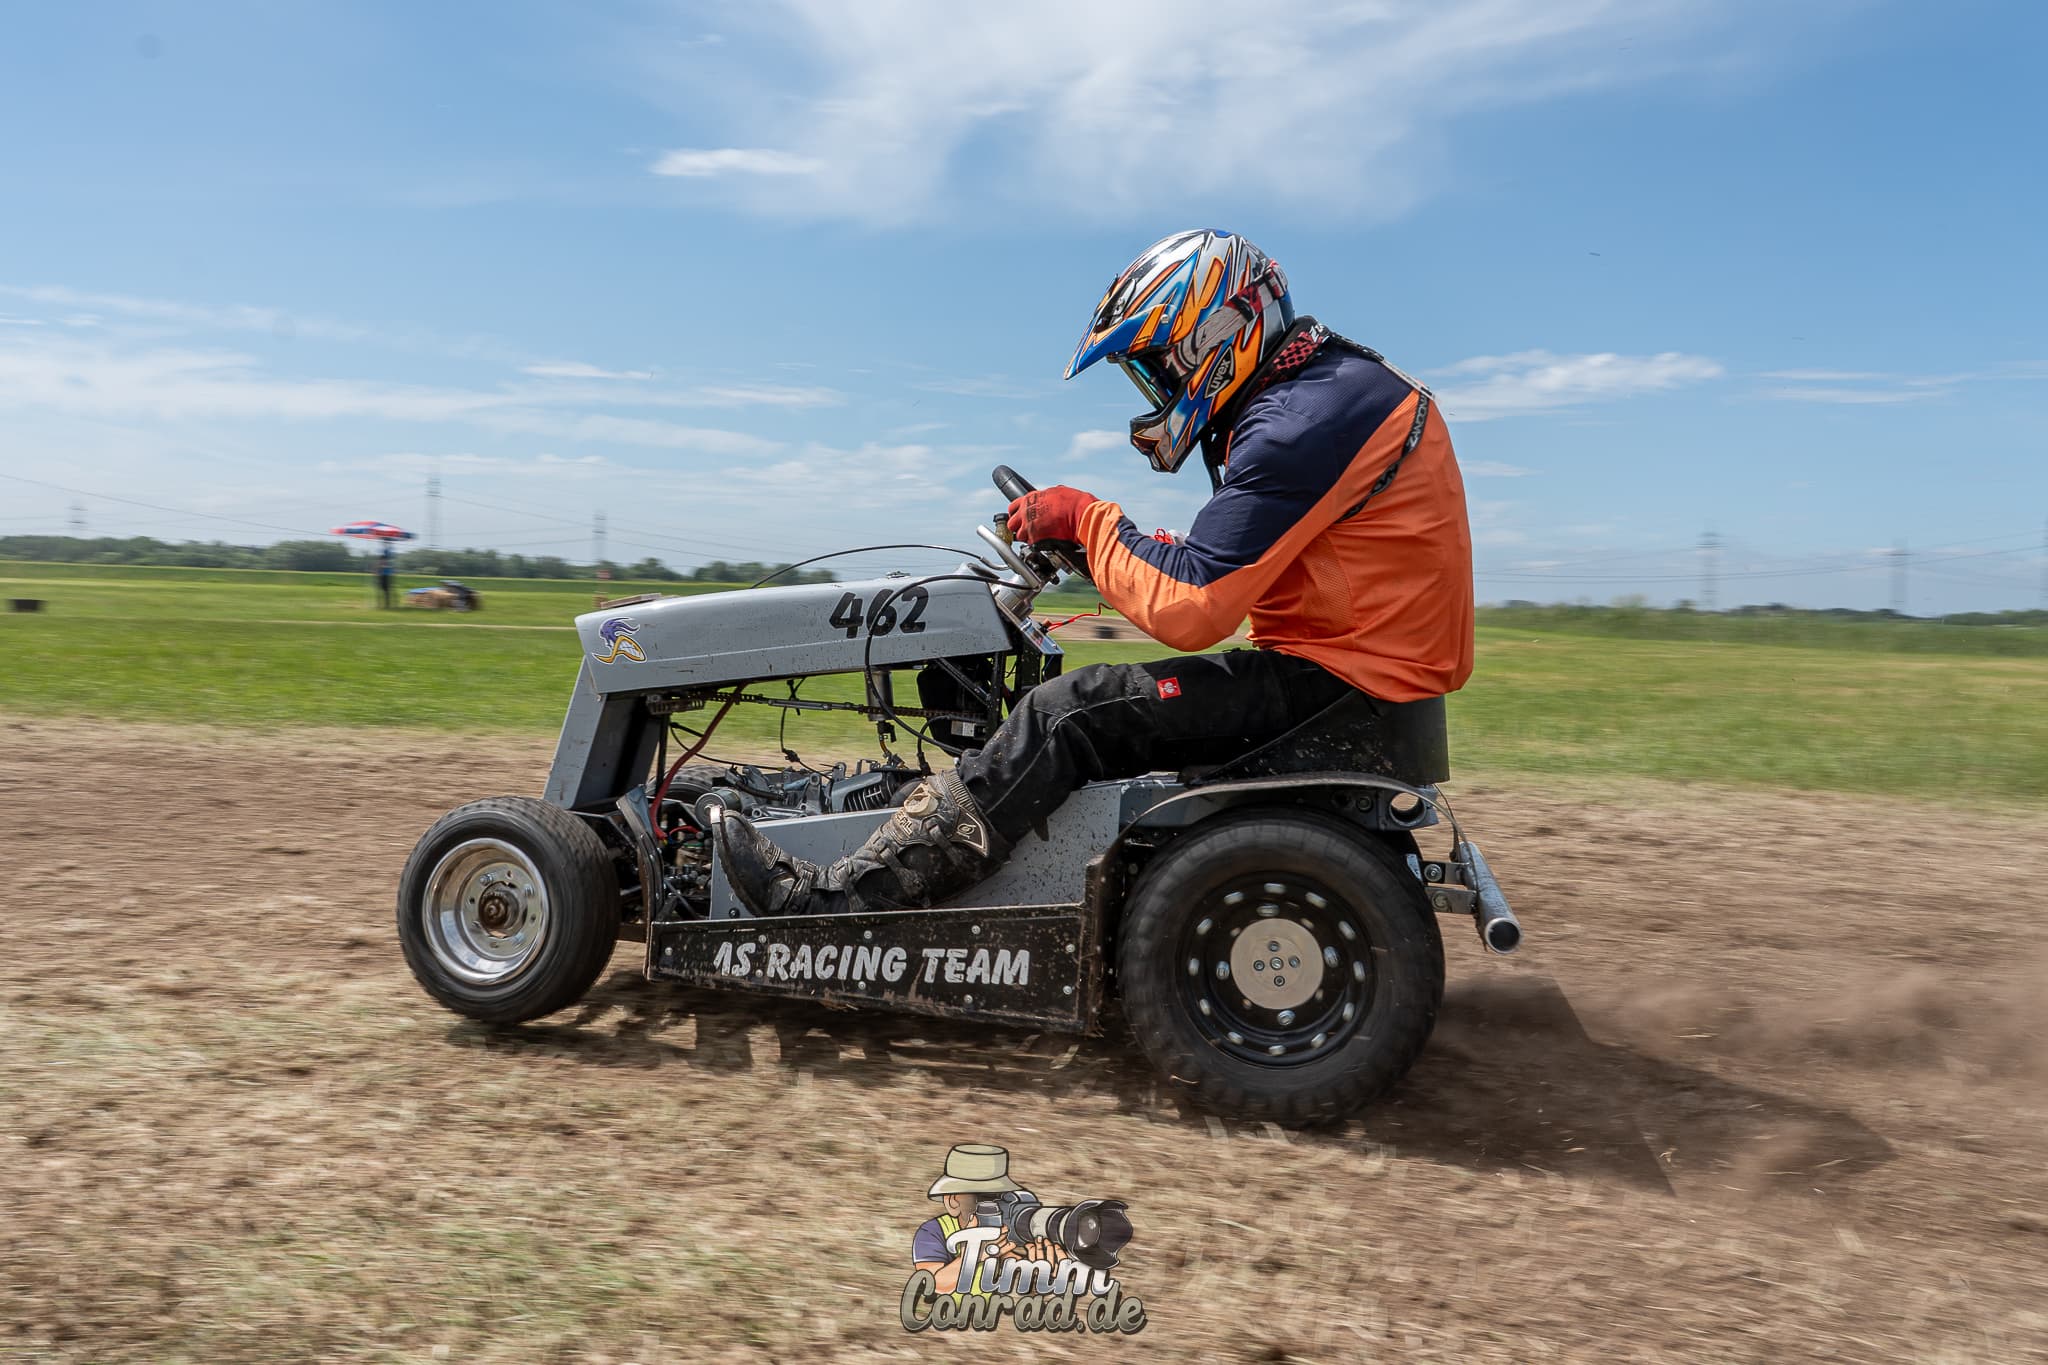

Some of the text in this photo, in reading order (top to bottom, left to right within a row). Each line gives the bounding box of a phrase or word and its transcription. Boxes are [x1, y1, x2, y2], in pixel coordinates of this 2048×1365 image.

[1210, 359, 1231, 389] uvex
[829, 586, 929, 638] 462
[767, 943, 907, 982] RACING
[922, 948, 1030, 985] TEAM
